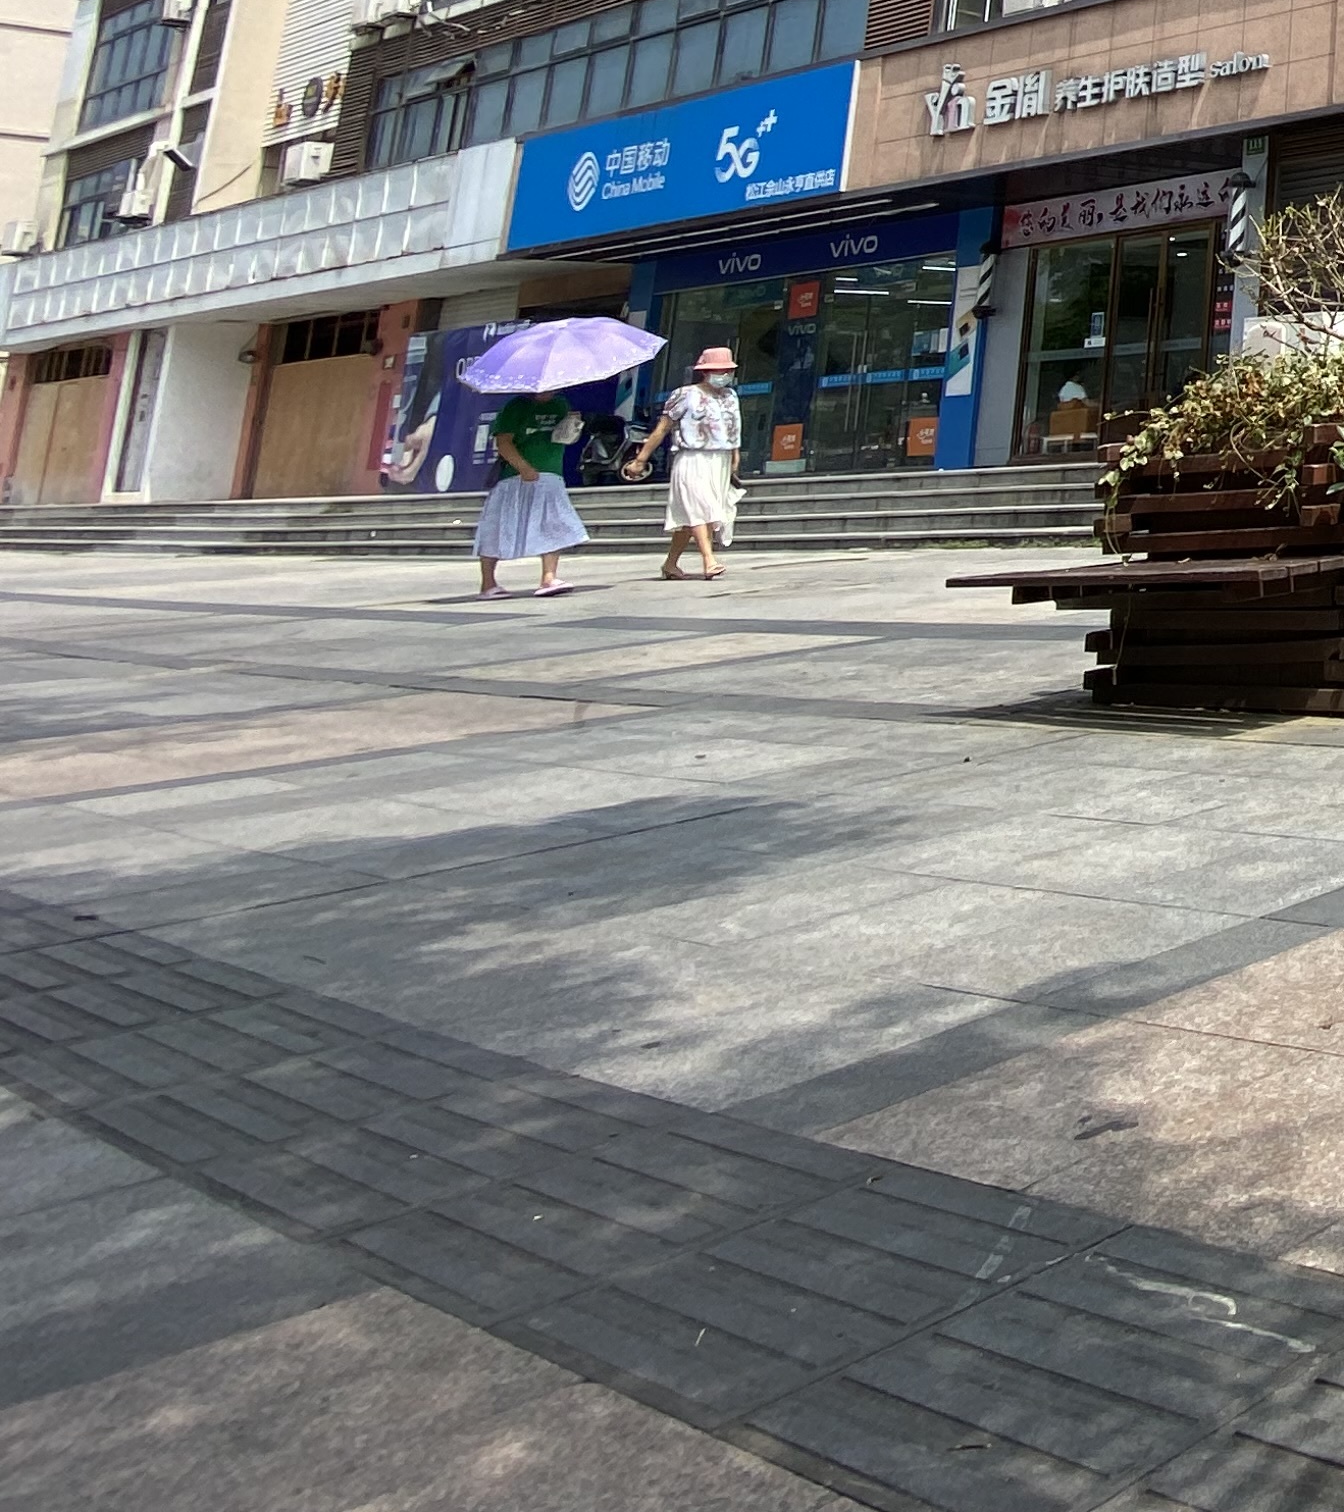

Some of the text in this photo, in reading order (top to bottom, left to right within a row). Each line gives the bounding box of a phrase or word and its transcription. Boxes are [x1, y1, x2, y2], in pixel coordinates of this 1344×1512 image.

[1208, 50, 1274, 80] salon
[605, 137, 671, 178] 中国移动
[601, 171, 667, 200] China Mobile
[829, 234, 879, 259] vivo
[718, 252, 762, 275] vivo
[787, 322, 817, 337] vivo
